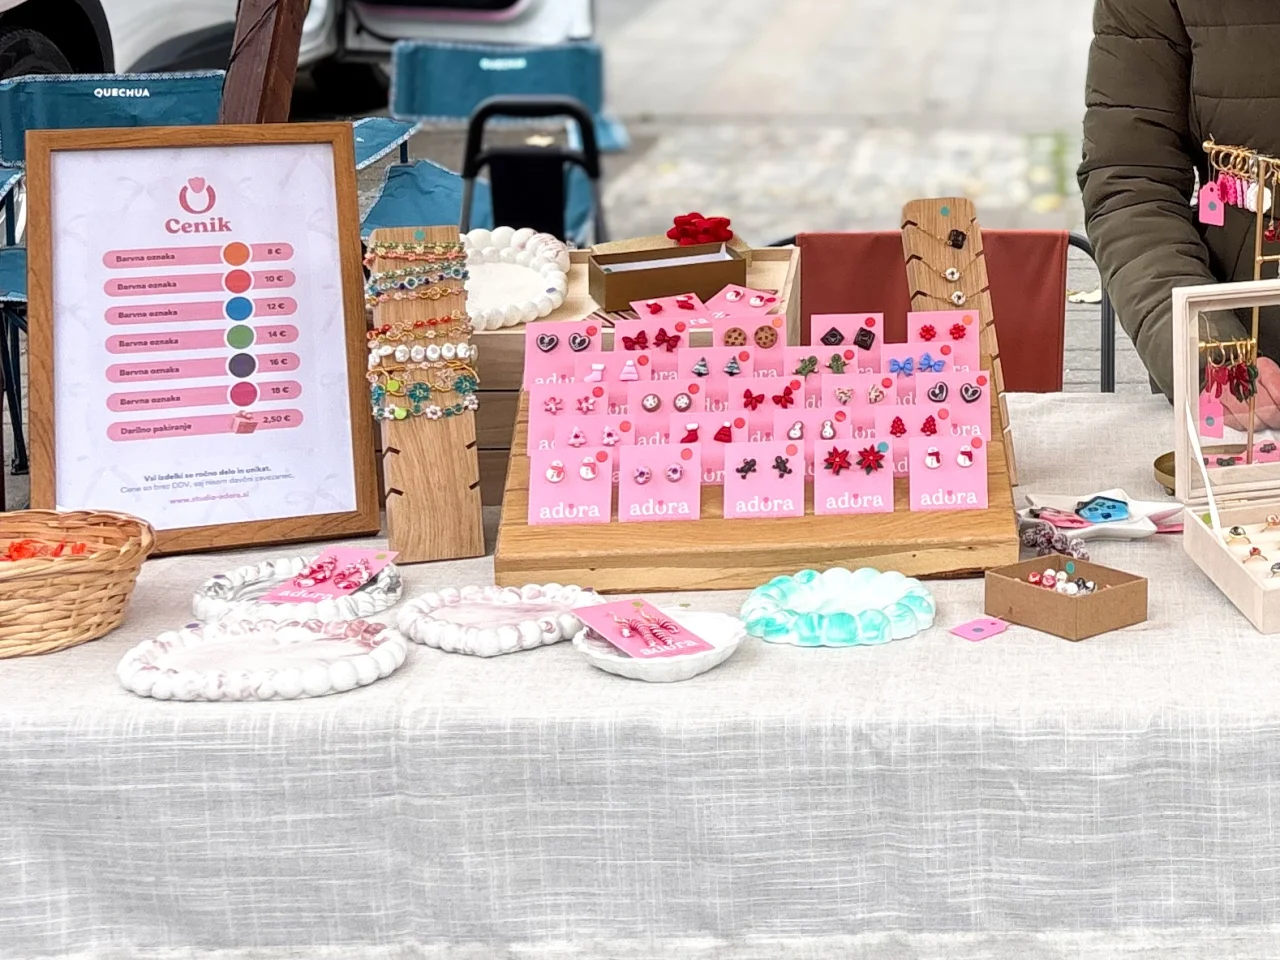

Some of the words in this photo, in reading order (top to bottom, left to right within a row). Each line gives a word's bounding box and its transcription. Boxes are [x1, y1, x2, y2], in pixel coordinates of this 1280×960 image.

[94, 88, 150, 98] QUECHUA
[165, 217, 232, 234] Cenik
[116, 254, 145, 263] Barvna
[117, 282, 147, 290] Barvna
[118, 311, 147, 319] Barvna
[268, 330, 278, 338] 14
[270, 358, 279, 366] 16
[120, 398, 149, 406] Barvna
[263, 415, 282, 424] 2,50
[121, 426, 151, 435] Darilno
[153, 423, 192, 433] pakiranje
[825, 493, 884, 510] adora
[921, 490, 978, 507] adora
[630, 499, 690, 516] adora
[736, 496, 795, 514] adora
[540, 503, 600, 520] adora
